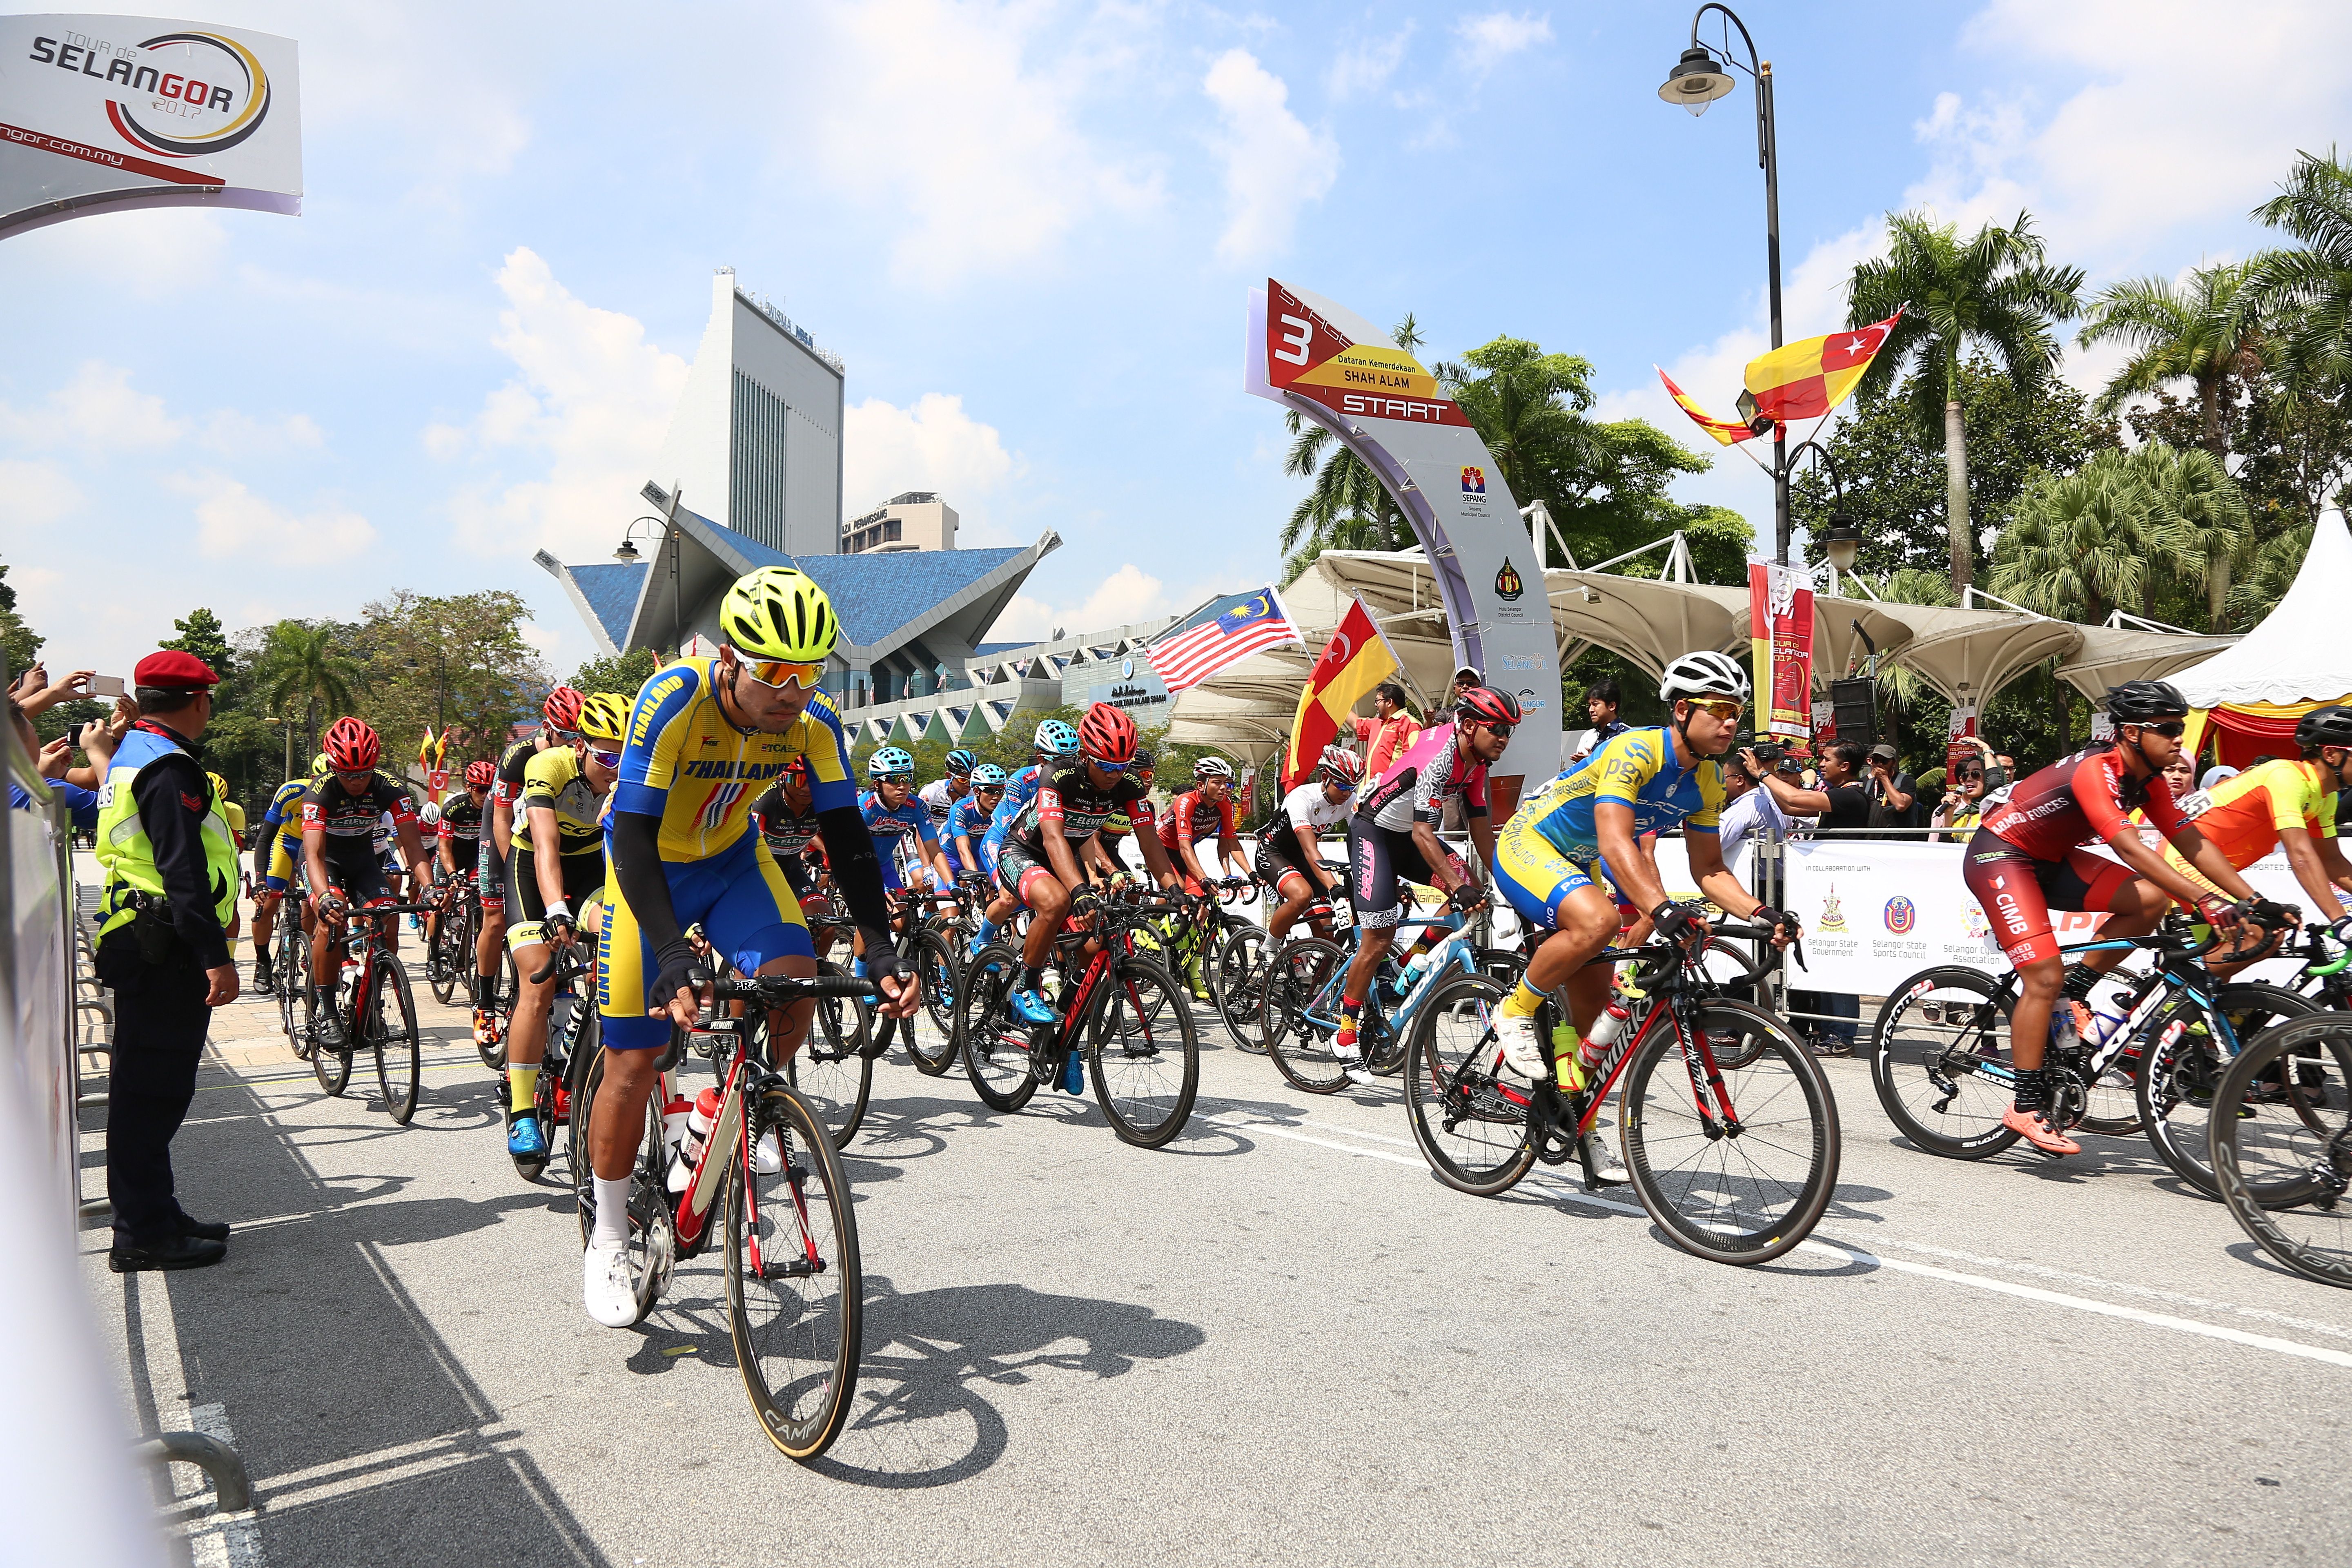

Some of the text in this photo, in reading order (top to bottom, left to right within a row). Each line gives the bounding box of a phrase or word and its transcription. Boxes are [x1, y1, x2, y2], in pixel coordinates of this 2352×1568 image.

[66, 30, 137, 62] TOUR de
[29, 36, 234, 113] SELANGOR
[153, 98, 202, 119] 2017
[1278, 287, 1356, 349] STAGE
[1274, 313, 1313, 366] 3
[1338, 354, 1416, 373] Dataran Kemerdekaan
[1344, 370, 1410, 389] SHAH ALAM
[1343, 395, 1448, 421] START
[1463, 494, 1486, 503] SEPANG
[853, 508, 887, 530] PERANGSANG
[1774, 647, 1809, 659] ELANGOR
[630, 675, 684, 748] THAILAND
[814, 689, 844, 731] HAIL
[1112, 698, 1134, 707] SULTAN
[1134, 696, 1150, 705] ALAM
[1150, 694, 1166, 703] SHAH
[502, 739, 533, 770] TAOKAS
[766, 744, 787, 752] TCA
[684, 760, 791, 780] THAILAND
[1051, 767, 1075, 783] TAOKAS
[1123, 771, 1144, 789] OKAS
[311, 770, 336, 795] TAOKA
[276, 787, 300, 804] THAILAND
[1179, 797, 1190, 818] CIMB
[1990, 797, 2070, 835] ARMED FORCES
[1065, 814, 1107, 825] 7-ELEVEN
[1132, 816, 1150, 825] CCN
[1361, 837, 1376, 901] SITRA
[1560, 874, 1592, 892] PGN
[973, 909, 980, 923] 26
[1336, 904, 1350, 927] 133
[1996, 893, 2029, 935] CIMB
[597, 903, 615, 1005] THAILAND
[1180, 933, 1201, 969] SCO
[1808, 939, 1858, 948] Selangor State
[1812, 947, 1853, 956] Government
[1873, 940, 1927, 949] Selangor State
[1873, 949, 1926, 959] Sports Council
[1944, 944, 1978, 955] Selangor
[1953, 955, 2000, 964] Association
[1068, 959, 1100, 1021] TAOKAS
[2091, 980, 2168, 1074] KHS
[1582, 995, 1654, 1110] S-WORKS
[1470, 1089, 1528, 1120] VENGE
[748, 1102, 757, 1173] SPECIALIZED
[782, 1126, 797, 1168] SPECIAL
[2218, 1141, 2352, 1274] CAMPAGN
